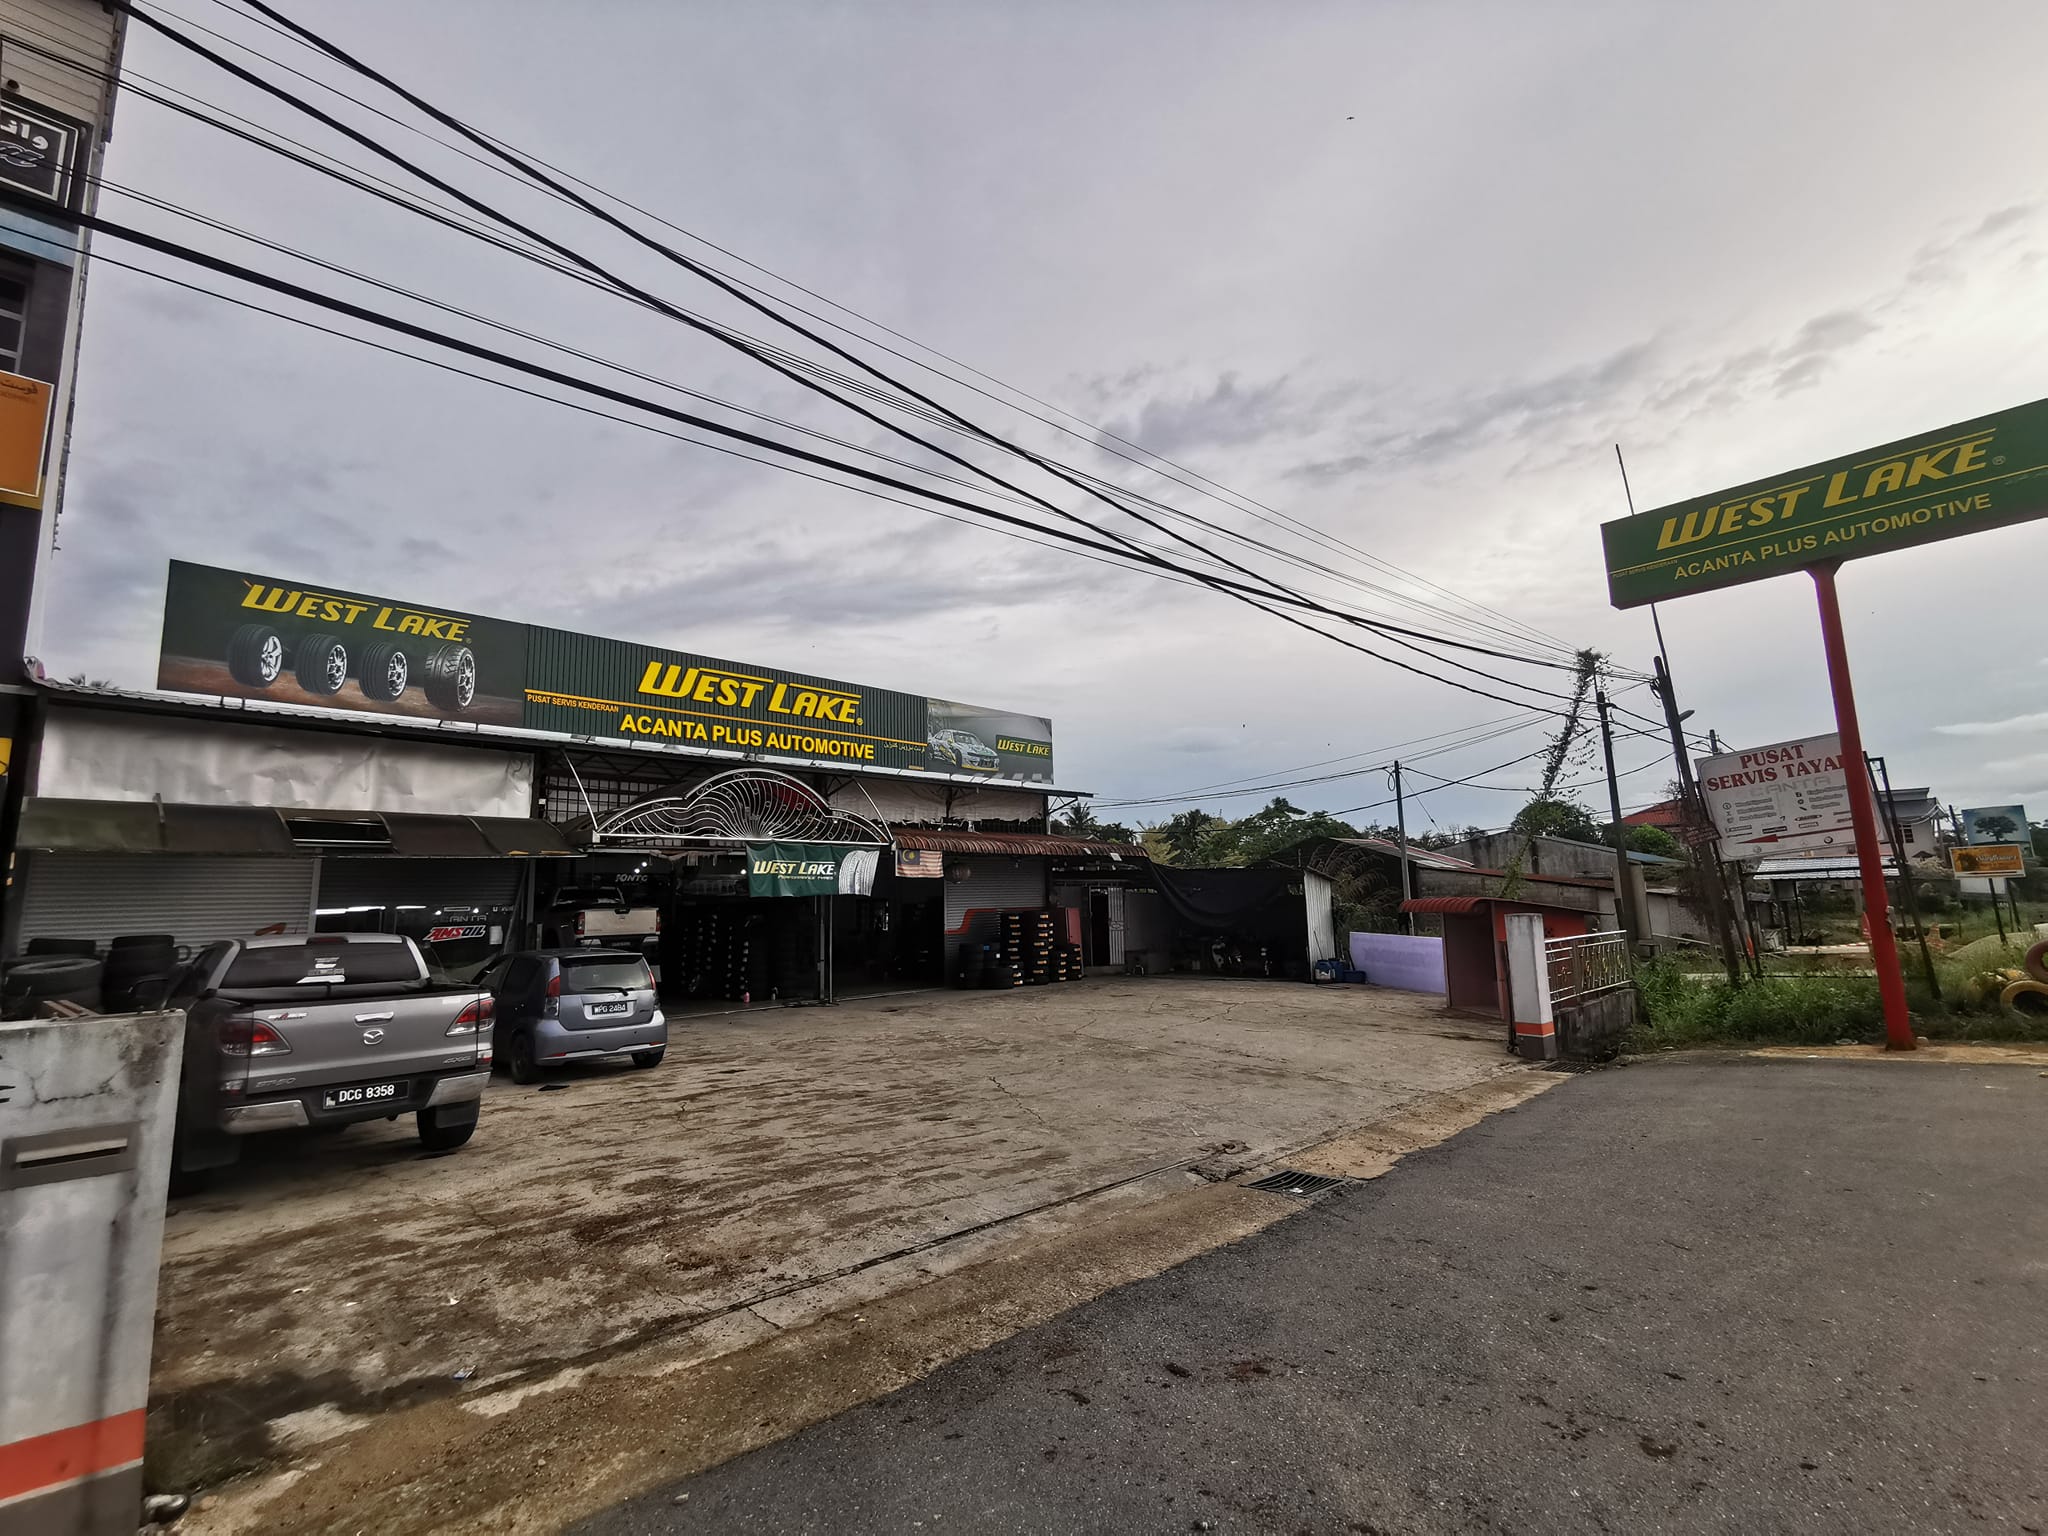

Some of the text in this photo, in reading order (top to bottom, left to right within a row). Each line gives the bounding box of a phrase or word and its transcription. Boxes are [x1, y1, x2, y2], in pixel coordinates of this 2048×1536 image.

[1656, 436, 1994, 551] WEST LAKE
[1673, 493, 1992, 580] ACANTA PLUS AUTOMOTIVE
[241, 583, 471, 643] WEST LAKE
[527, 694, 619, 713] PUSAT SERVIS KENDERAAN
[638, 661, 860, 724] WEST LAKE
[620, 713, 875, 760] ACANTA PLUS AUTOMOTIVE
[997, 739, 1049, 756] WEST LAKE
[1739, 744, 1804, 770] PUSAT
[1707, 767, 1778, 792] SERVIS
[1782, 755, 1844, 779] TAYA
[753, 861, 835, 875] WEST LAKE
[424, 925, 486, 942] AMSOIL
[339, 1084, 395, 1102] DCG 8358
